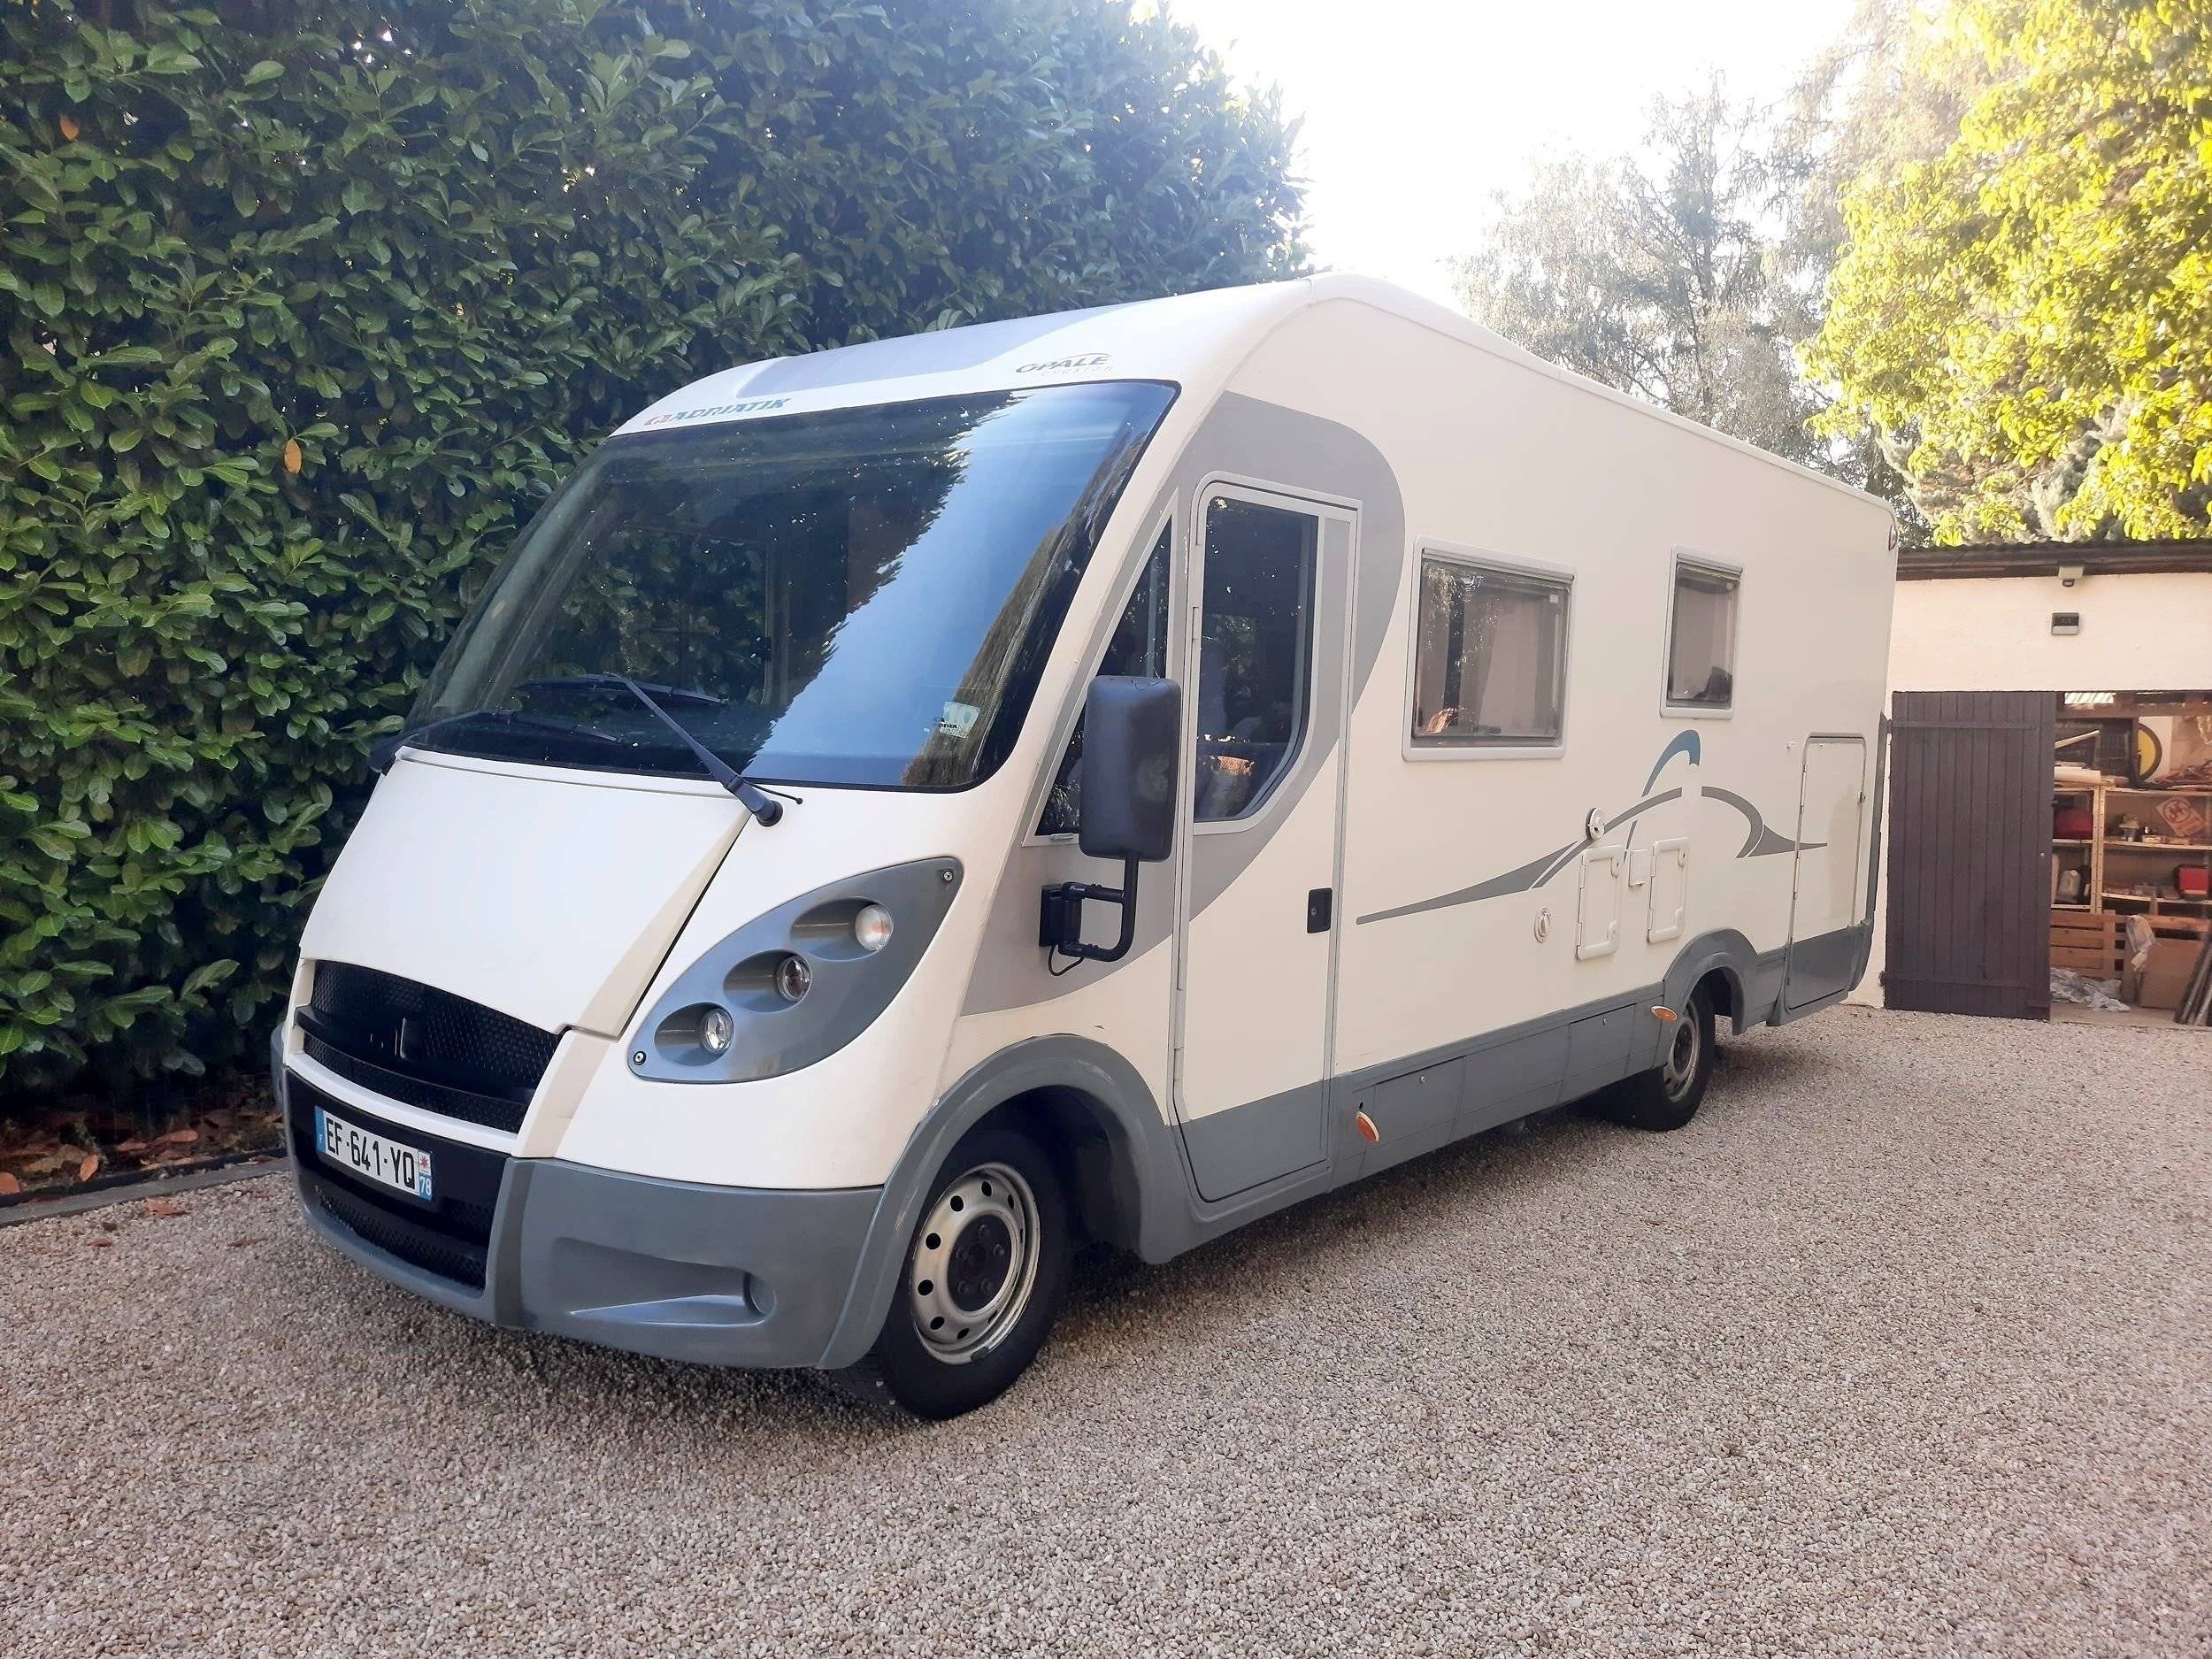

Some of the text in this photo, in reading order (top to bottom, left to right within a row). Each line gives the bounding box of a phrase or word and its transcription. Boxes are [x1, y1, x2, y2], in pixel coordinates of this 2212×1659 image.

[1015, 356, 1110, 373] OPALE
[669, 398, 792, 423] ADRIATIK
[326, 1117, 416, 1190] EF-641-YQ
[419, 1176, 432, 1195] 78
